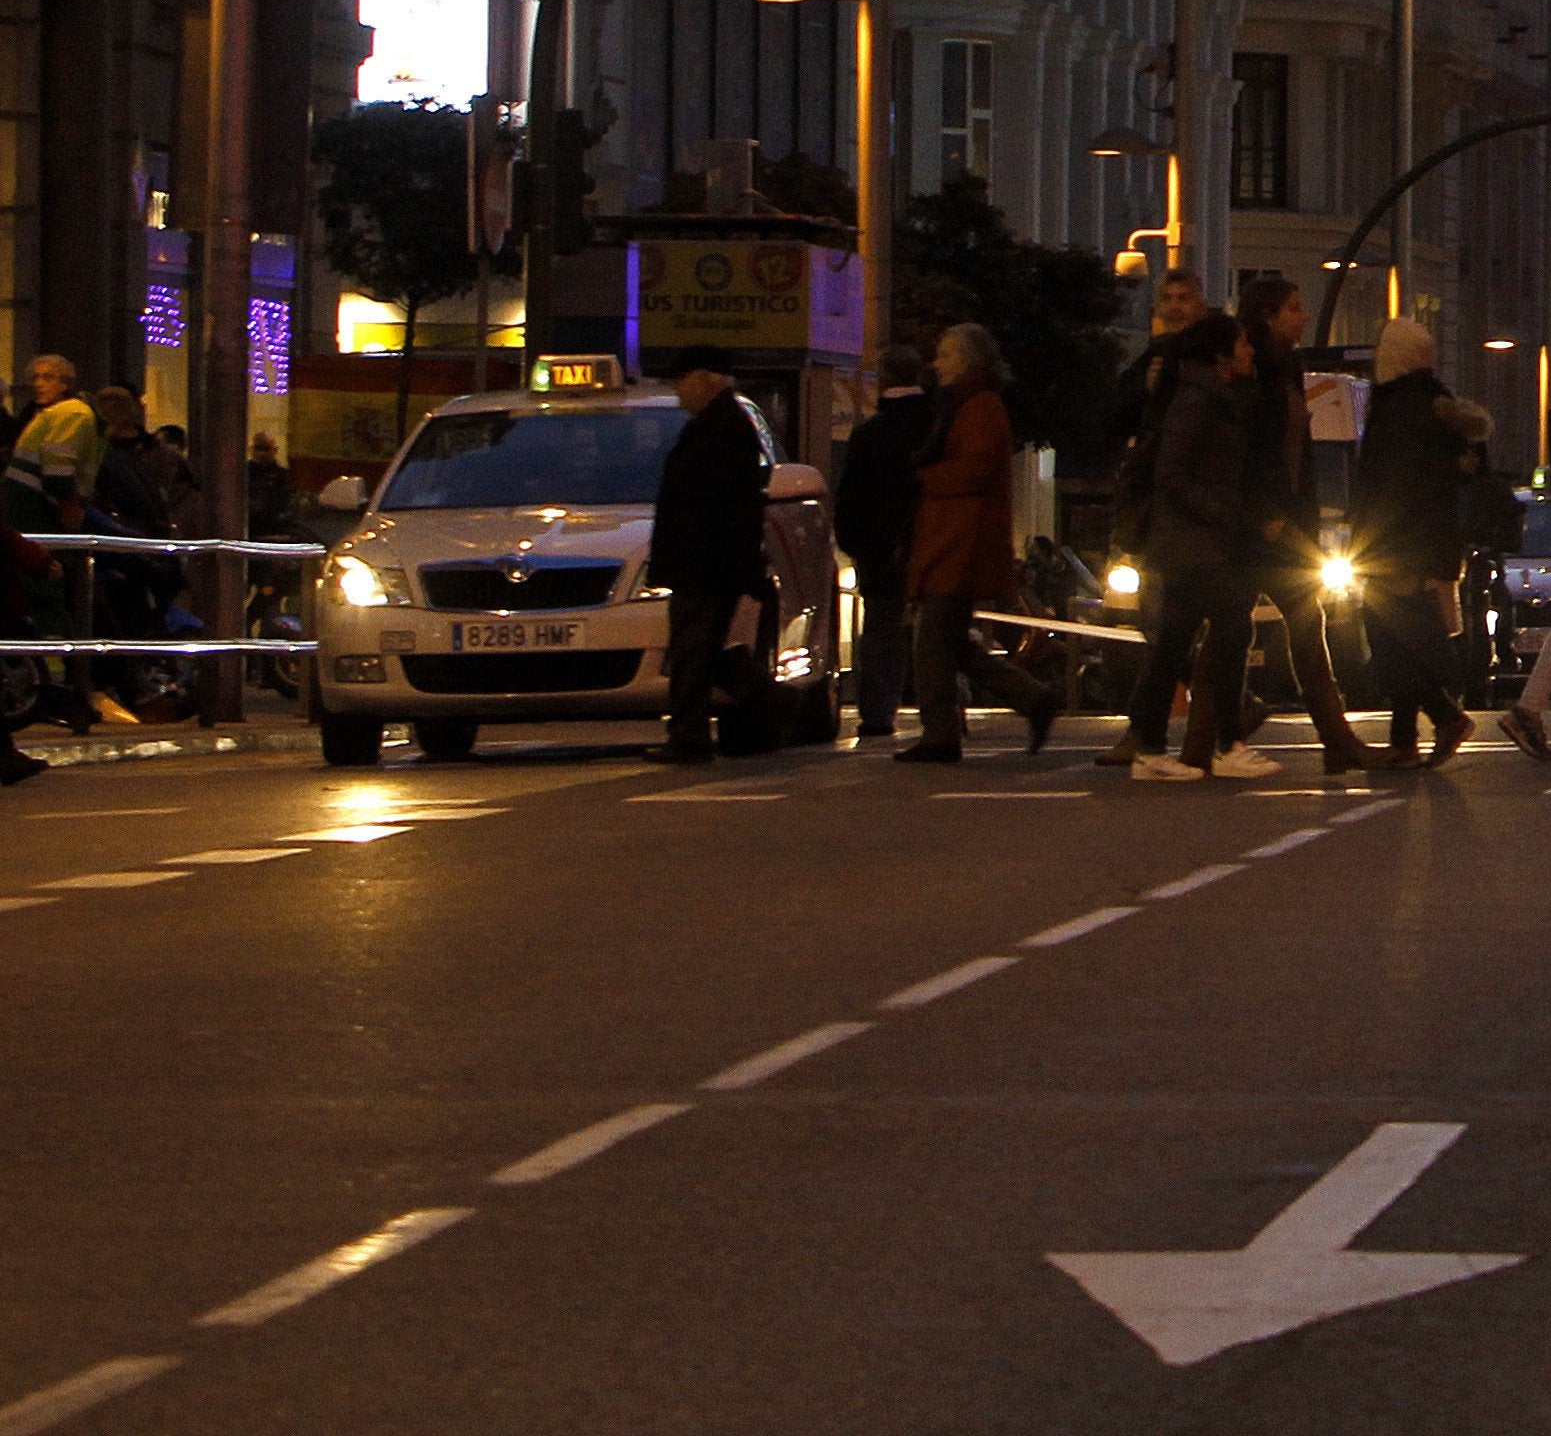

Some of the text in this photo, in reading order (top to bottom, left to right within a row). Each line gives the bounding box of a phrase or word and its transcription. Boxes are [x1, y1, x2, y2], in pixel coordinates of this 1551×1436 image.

[645, 294, 674, 312] US
[551, 365, 593, 386] TAXI
[467, 623, 580, 647] 8289 HMF
